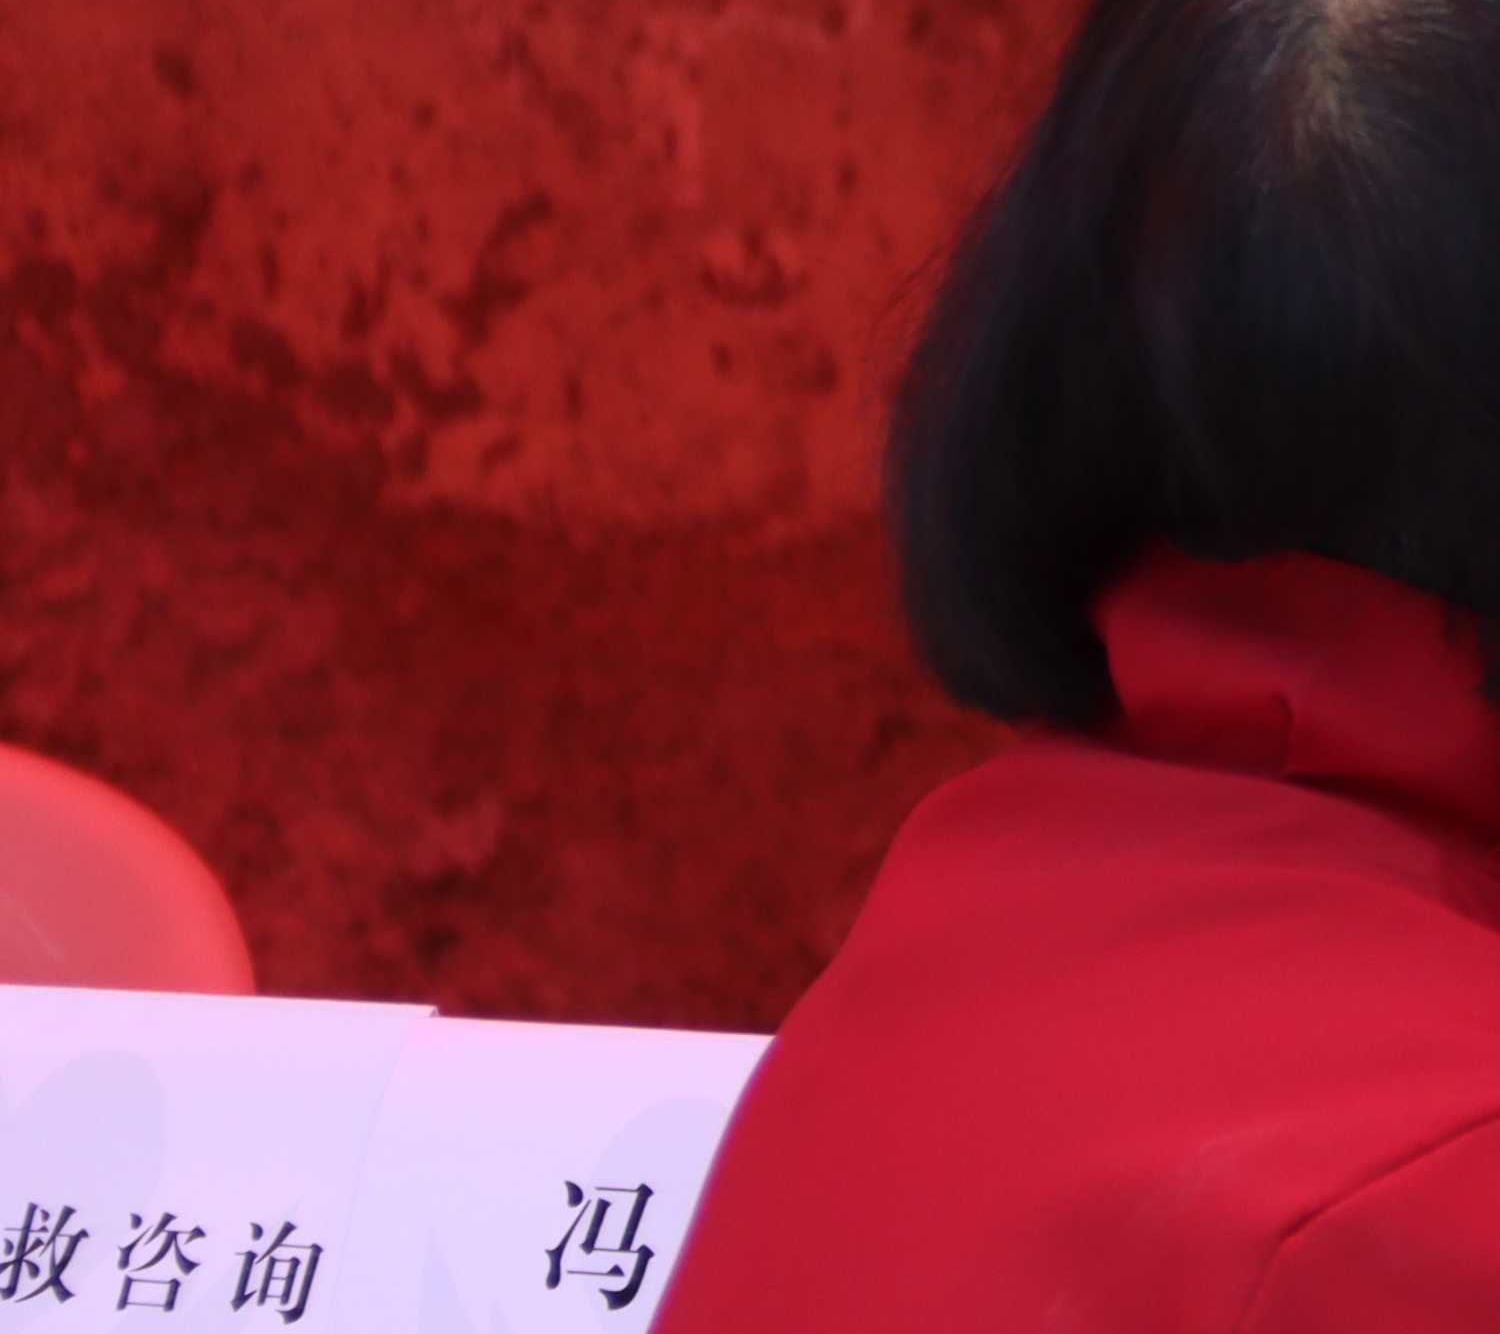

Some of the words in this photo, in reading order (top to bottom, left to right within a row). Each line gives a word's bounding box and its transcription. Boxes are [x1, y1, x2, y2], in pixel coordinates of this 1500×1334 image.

[0, 1201, 324, 1325] 救咨询
[544, 1180, 655, 1312] 冯
